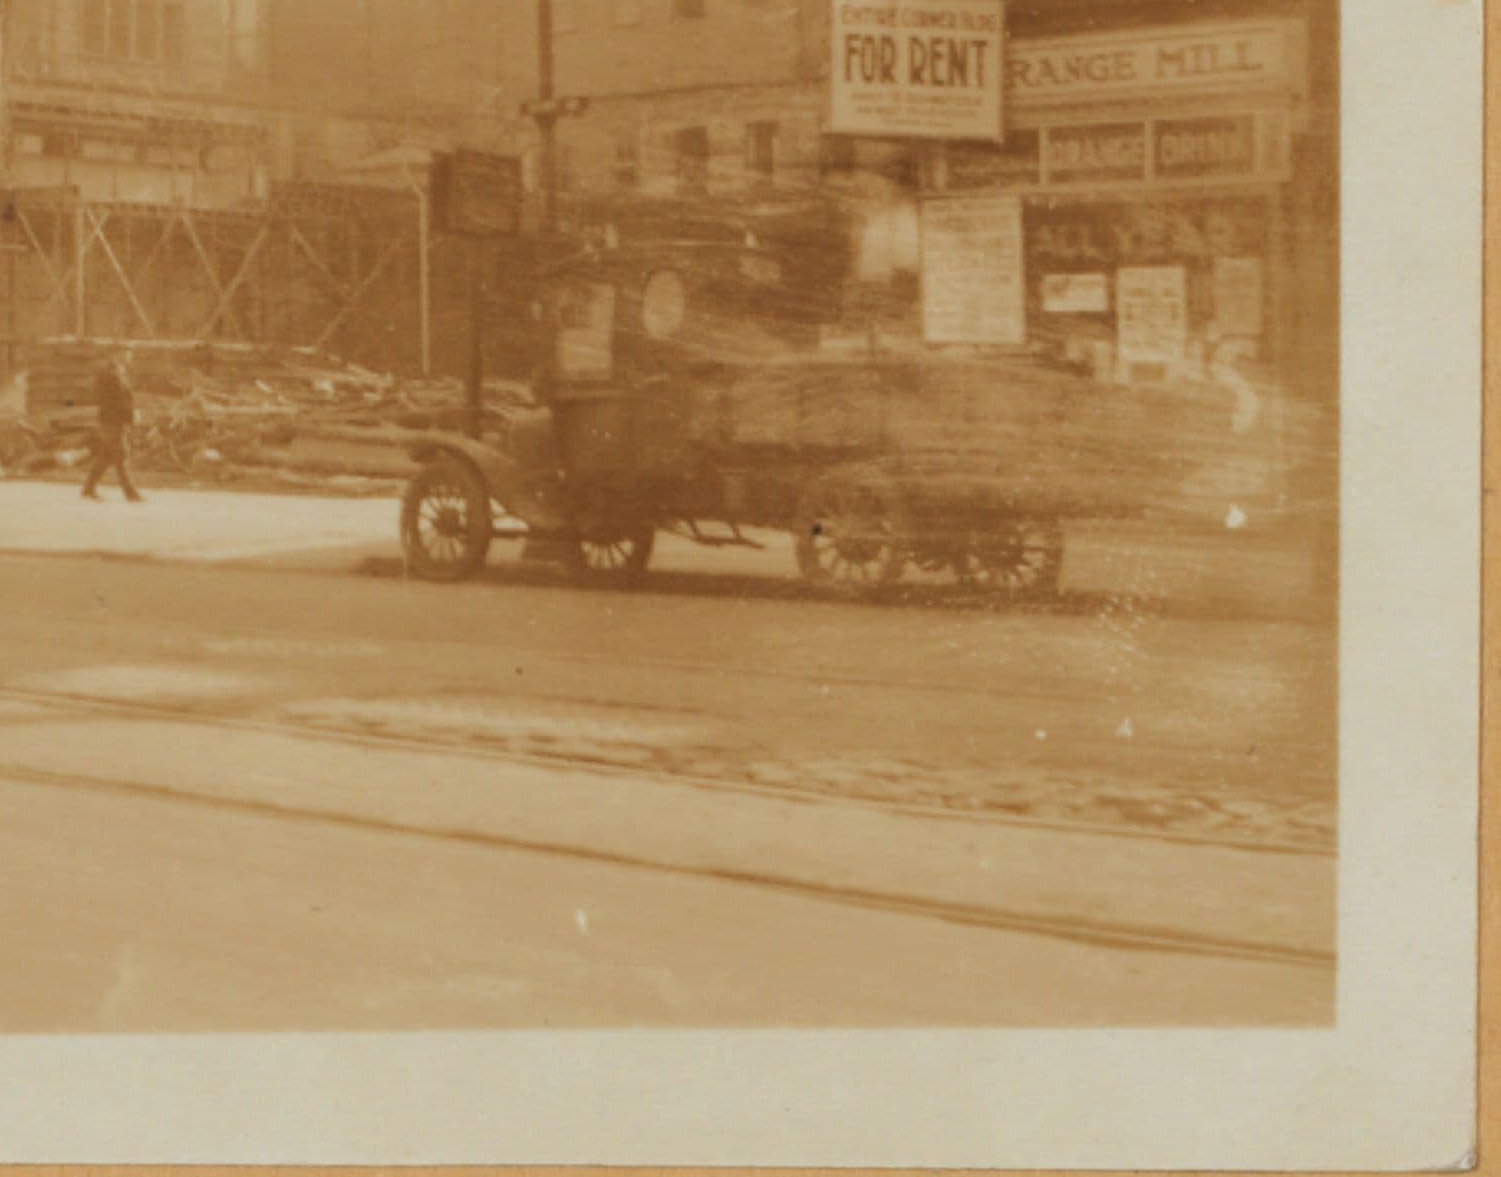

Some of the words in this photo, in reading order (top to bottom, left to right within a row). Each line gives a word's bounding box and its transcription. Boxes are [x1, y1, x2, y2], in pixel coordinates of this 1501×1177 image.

[844, 32, 897, 85] FOR
[908, 34, 988, 89] RENT
[1007, 53, 1136, 87] RANGE
[1155, 42, 1263, 77] MILL
